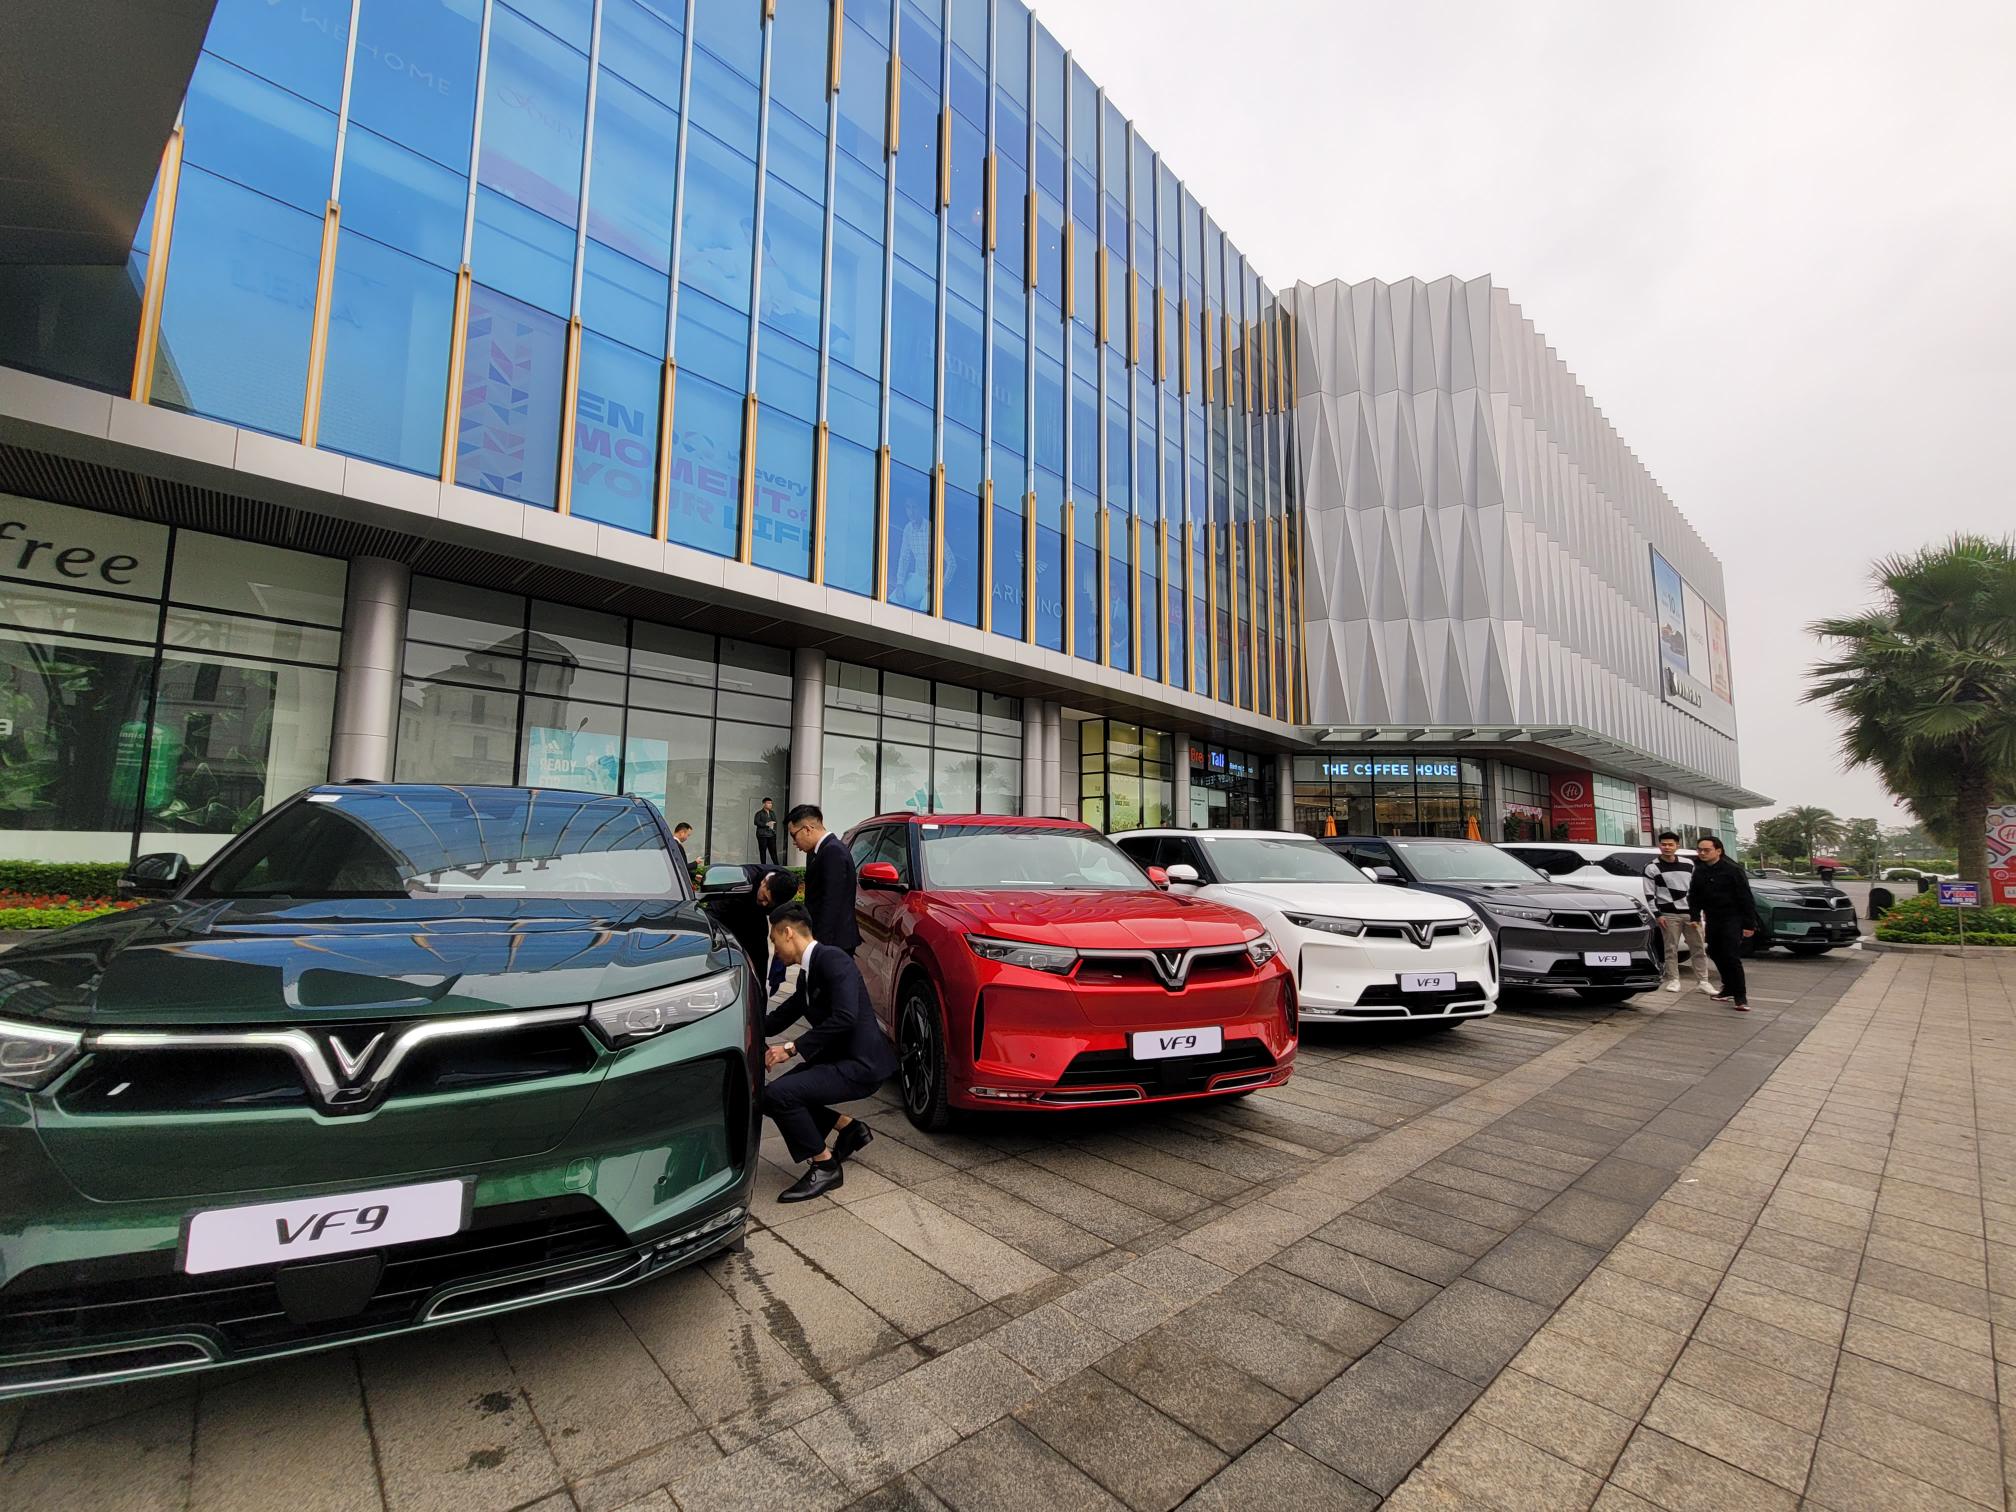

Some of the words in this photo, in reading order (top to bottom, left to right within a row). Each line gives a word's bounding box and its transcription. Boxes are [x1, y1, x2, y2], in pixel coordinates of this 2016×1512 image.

[1322, 763, 1349, 775] THE
[1353, 763, 1410, 776] COFFEE
[1415, 764, 1457, 776] HOUSE
[1598, 955, 1618, 963] VF9
[1417, 977, 1440, 987] VF9
[1159, 1035, 1197, 1051] VF9
[275, 1204, 389, 1245] VF9
